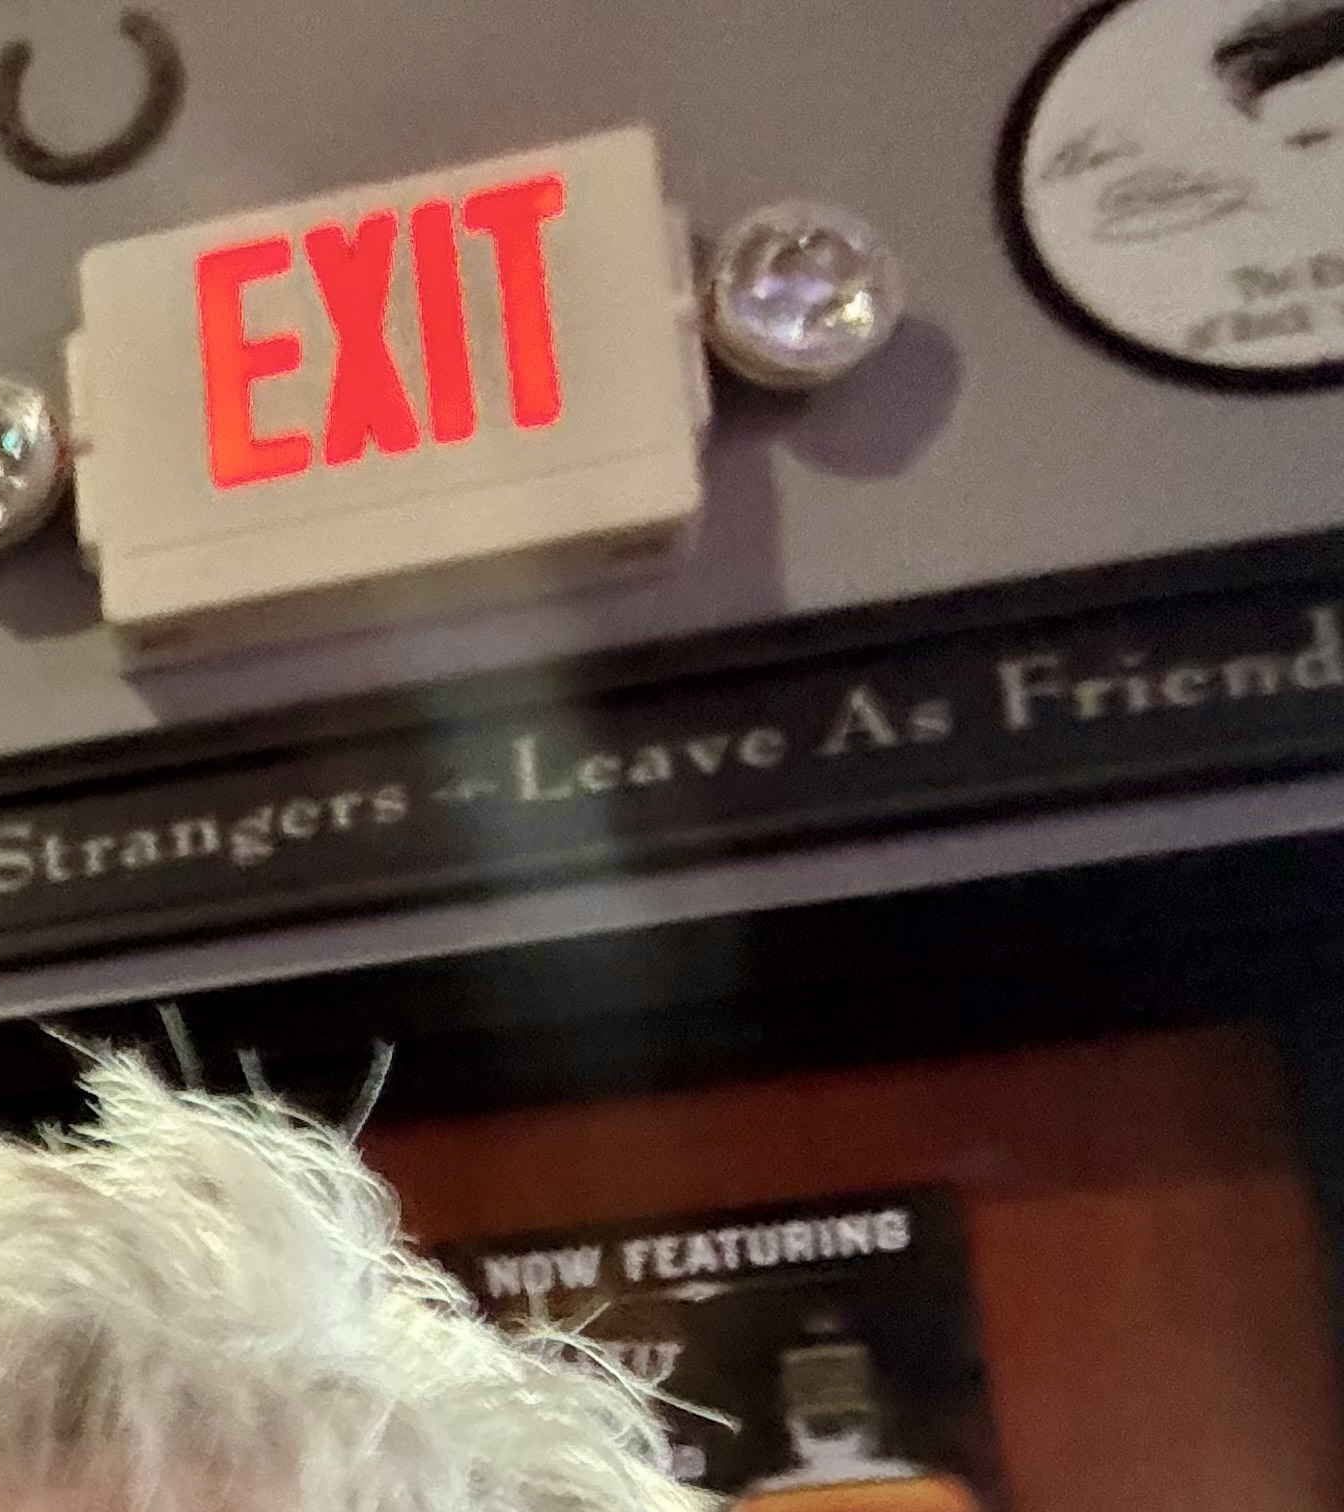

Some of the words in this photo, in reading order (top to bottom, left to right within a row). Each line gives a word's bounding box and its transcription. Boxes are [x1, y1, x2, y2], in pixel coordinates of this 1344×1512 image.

[194, 172, 568, 490] EXIT
[512, 722, 790, 803] Leave
[815, 682, 956, 756] As
[996, 605, 1344, 732] Friend
[484, 1245, 603, 1299] NOW
[622, 1208, 912, 1283] FEATURING
